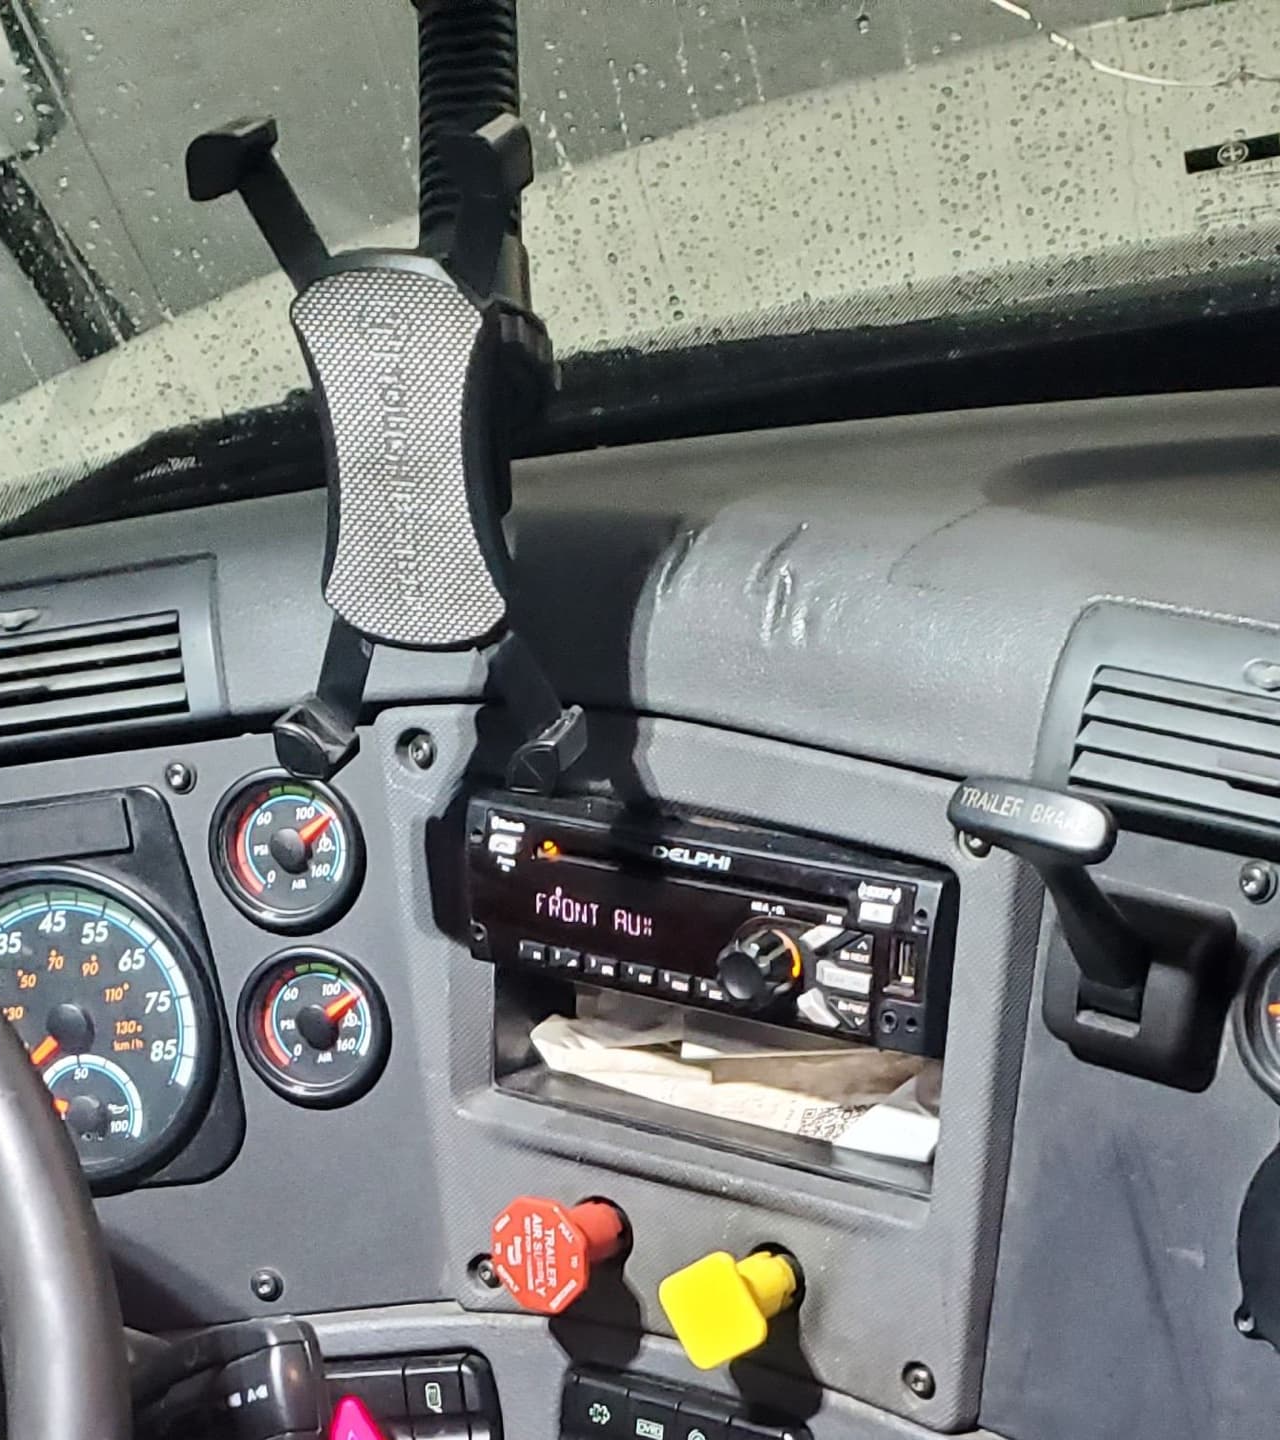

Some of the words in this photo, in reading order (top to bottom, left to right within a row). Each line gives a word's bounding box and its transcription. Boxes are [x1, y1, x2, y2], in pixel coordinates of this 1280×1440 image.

[257, 812, 272, 825] 60
[296, 807, 314, 820] 100
[960, 787, 1024, 817] TRAILER
[1031, 804, 1087, 836] BRA
[653, 846, 731, 871] DELPHI
[267, 870, 276, 882] 0
[311, 864, 330, 877] 160
[292, 879, 307, 890] AIR
[536, 893, 599, 926] FRONT
[614, 910, 652, 936] AUX
[39, 911, 66, 933] 45
[81, 921, 109, 944] 55
[48, 956, 64, 971] 70
[118, 949, 146, 972] 65
[82, 961, 99, 976] 90
[20, 974, 37, 989] 50
[104, 987, 123, 1002] 110
[283, 987, 299, 1001] 60
[322, 983, 341, 996] 100
[144, 991, 171, 1014] 75
[7, 1007, 24, 1020] 30
[115, 1021, 136, 1034] 130
[113, 1039, 144, 1051] km/h
[150, 1040, 177, 1062] 85
[294, 1044, 302, 1056] 0
[336, 1038, 355, 1051] 160
[317, 1053, 332, 1064] AIR
[74, 1068, 89, 1080] 50
[110, 1120, 129, 1132] 100
[531, 1213, 543, 1239] AIR
[545, 1228, 557, 1288] TRAILER
